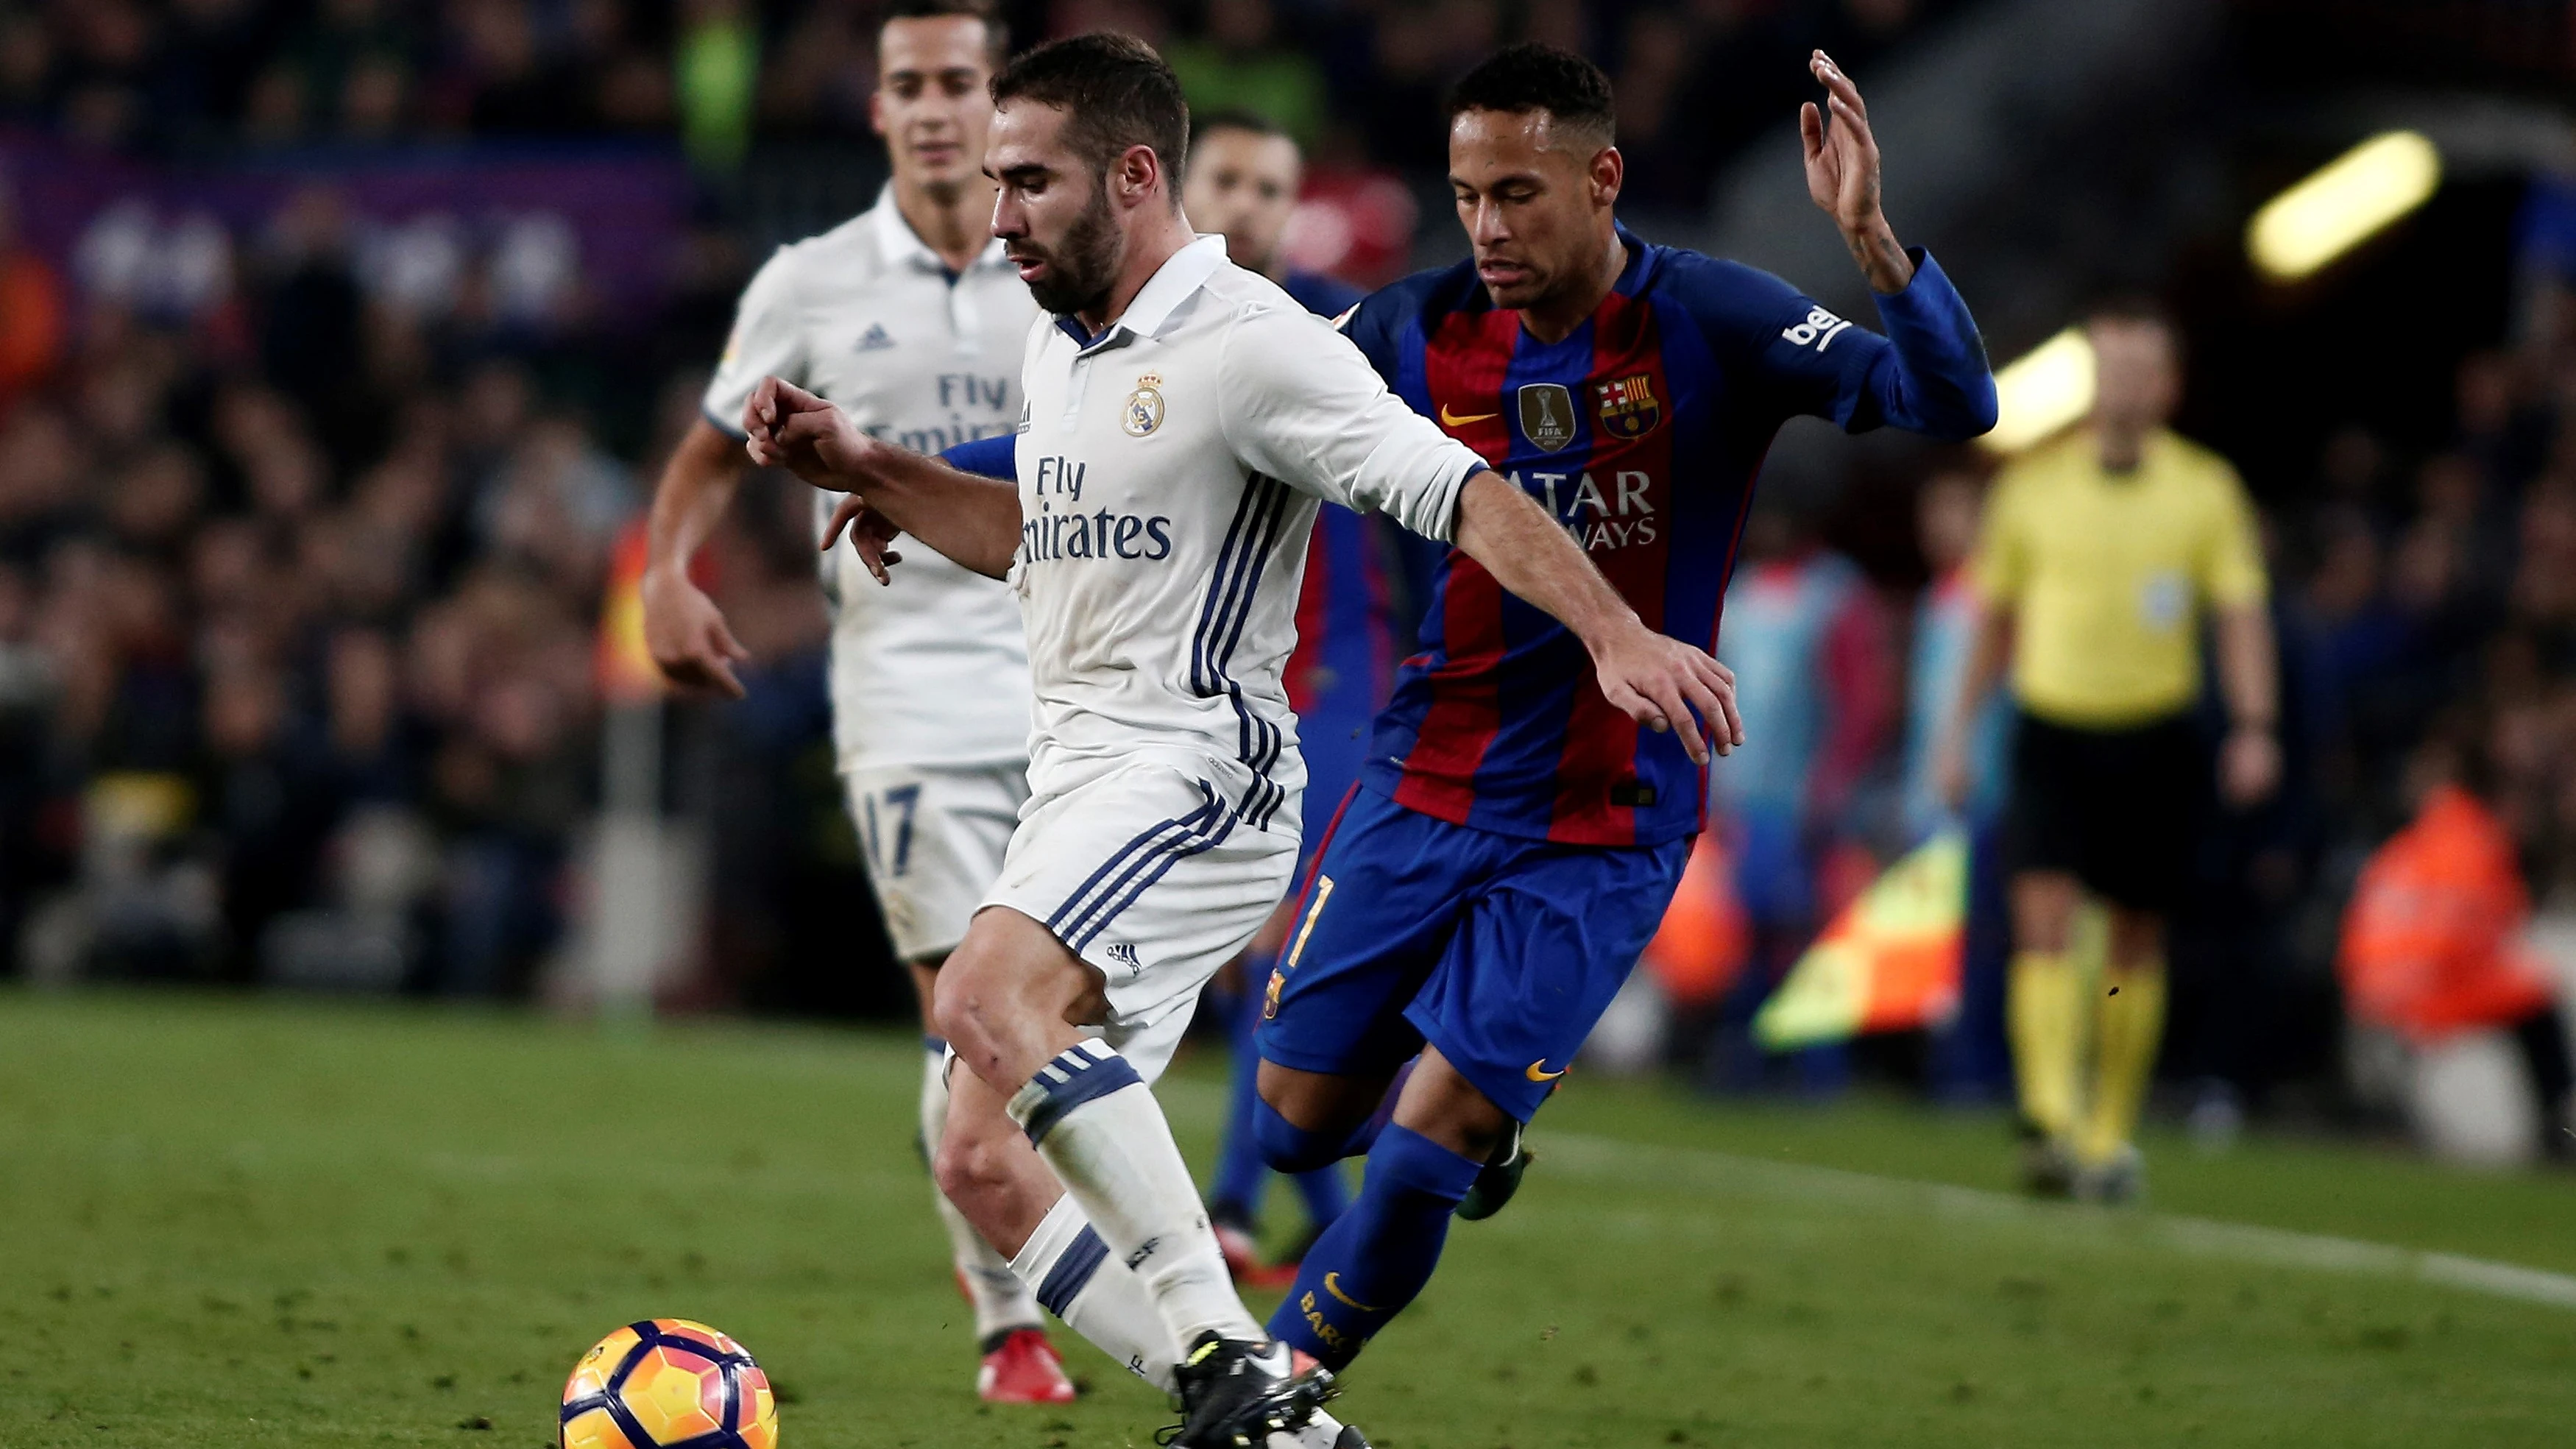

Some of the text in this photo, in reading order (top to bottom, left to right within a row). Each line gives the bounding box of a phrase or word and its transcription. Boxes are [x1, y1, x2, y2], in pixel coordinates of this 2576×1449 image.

[938, 373, 1008, 411] Fly
[1036, 456, 1086, 502] Fly
[864, 782, 923, 877] 17
